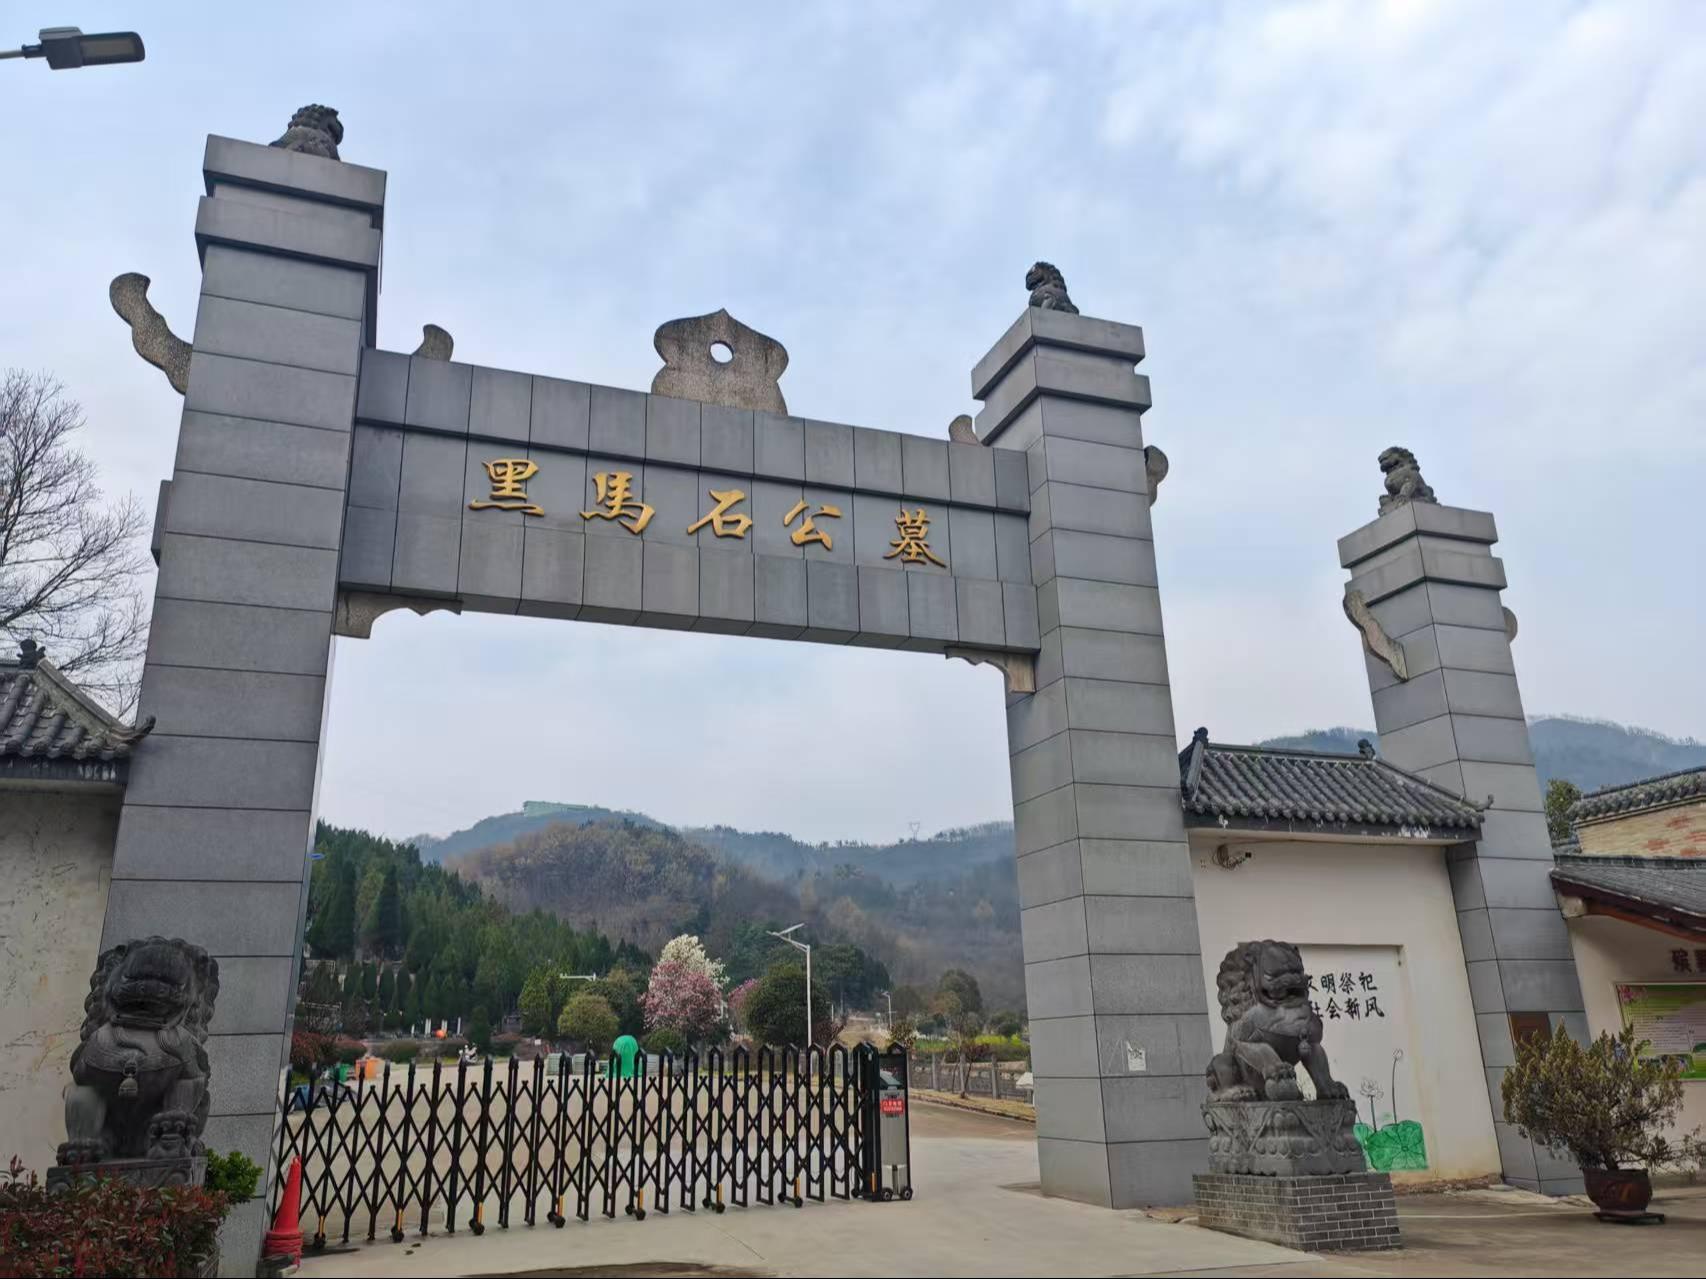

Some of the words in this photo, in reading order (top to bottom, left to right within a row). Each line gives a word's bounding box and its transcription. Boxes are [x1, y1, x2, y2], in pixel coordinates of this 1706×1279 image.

[468, 458, 946, 568] 黑馬石公墓
